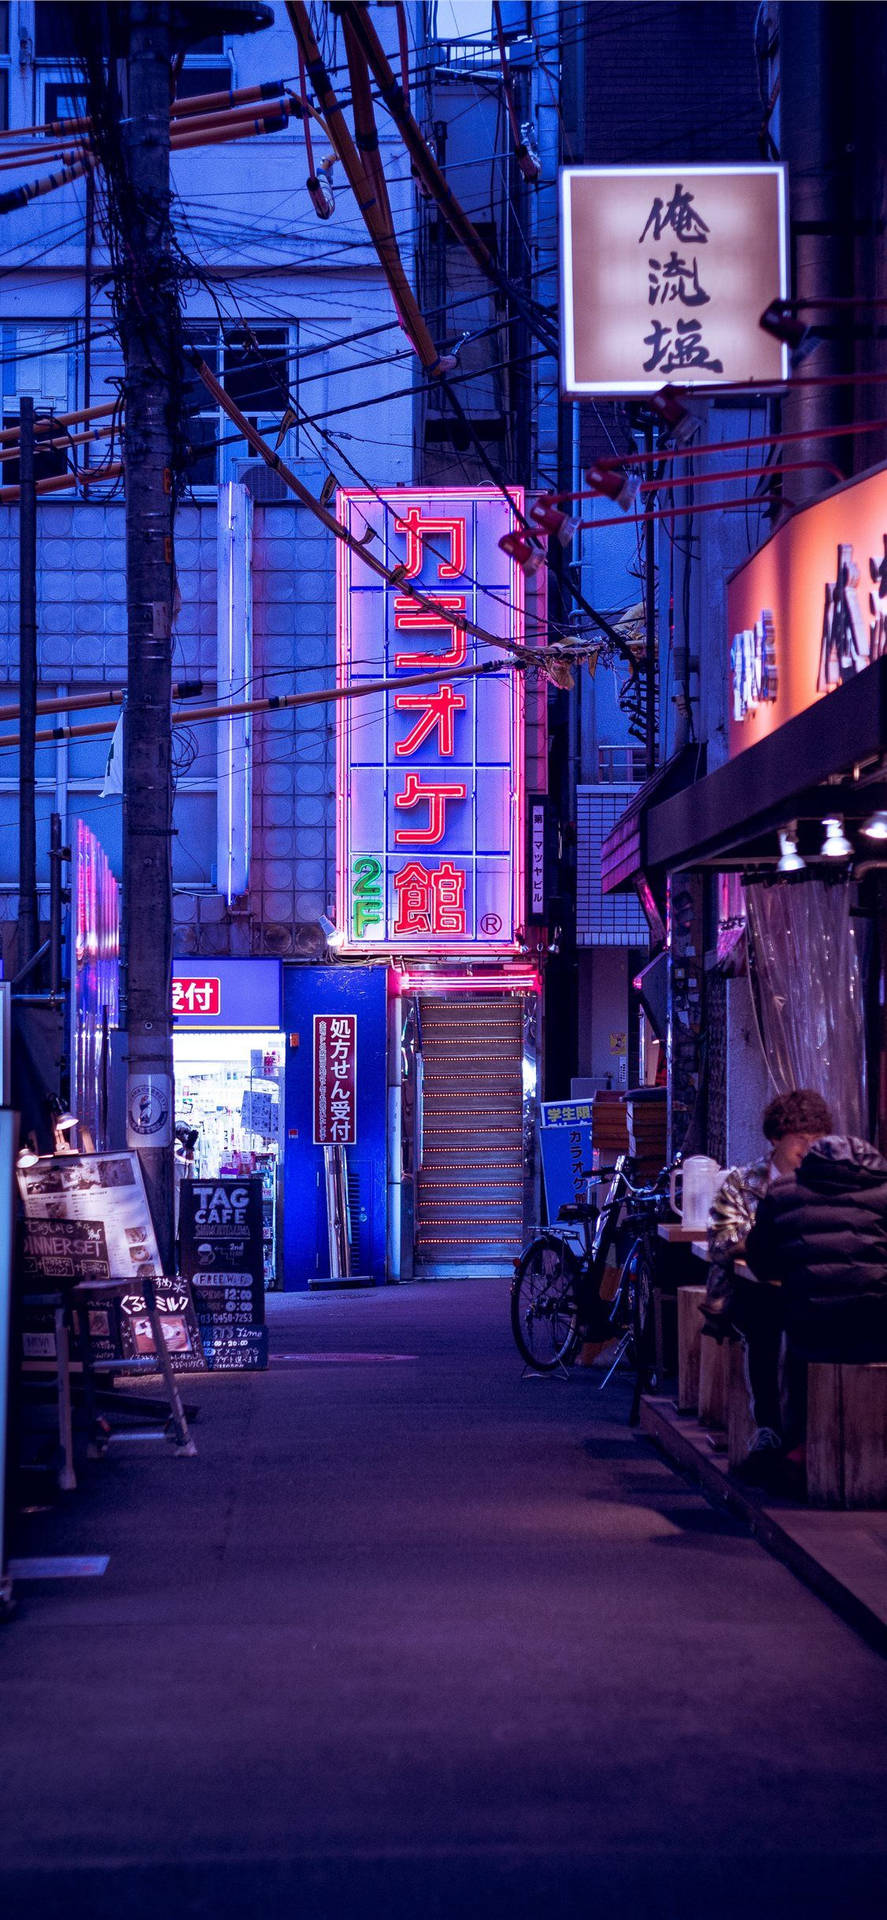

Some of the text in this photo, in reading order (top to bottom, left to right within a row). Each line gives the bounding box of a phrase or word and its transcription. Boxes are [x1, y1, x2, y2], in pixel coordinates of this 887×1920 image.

[638, 183, 723, 374] 俺流塩
[393, 505, 467, 935] カラオケ館
[352, 857, 382, 939] 2F
[533, 814, 543, 903] 第一マツヤビル
[329, 1018, 352, 1142] 処方せん受付
[547, 1104, 592, 1123] 学生限
[192, 1187, 250, 1209] TAG
[194, 1209, 247, 1224] CAFE
[224, 1287, 253, 1301] 12:00
